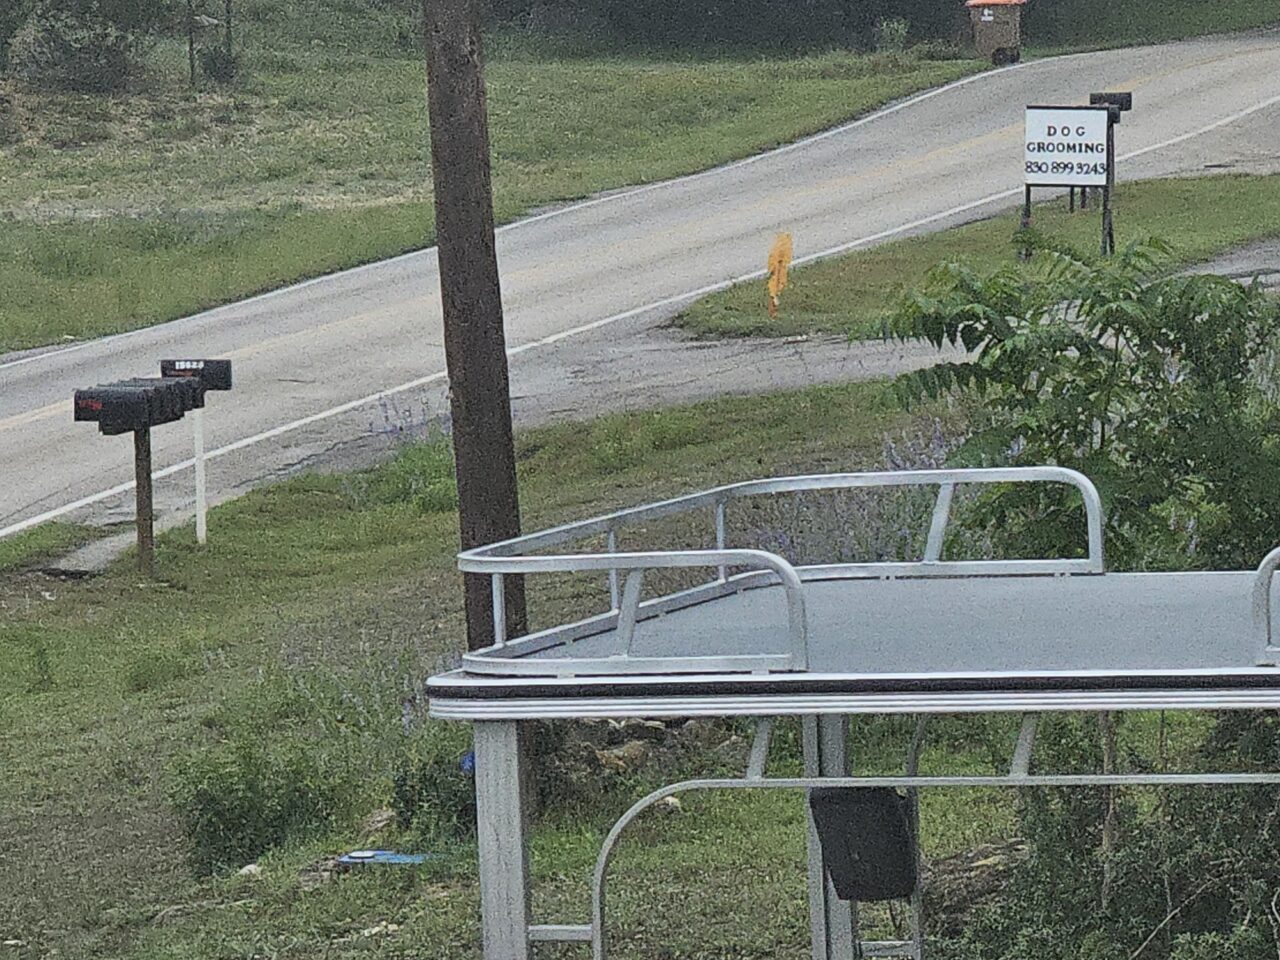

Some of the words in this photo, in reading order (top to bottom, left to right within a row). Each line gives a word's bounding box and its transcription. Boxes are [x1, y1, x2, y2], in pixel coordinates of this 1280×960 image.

[1047, 126, 1085, 137] DOG
[1026, 142, 1105, 153] GROOMING
[1025, 160, 1049, 174] 830
